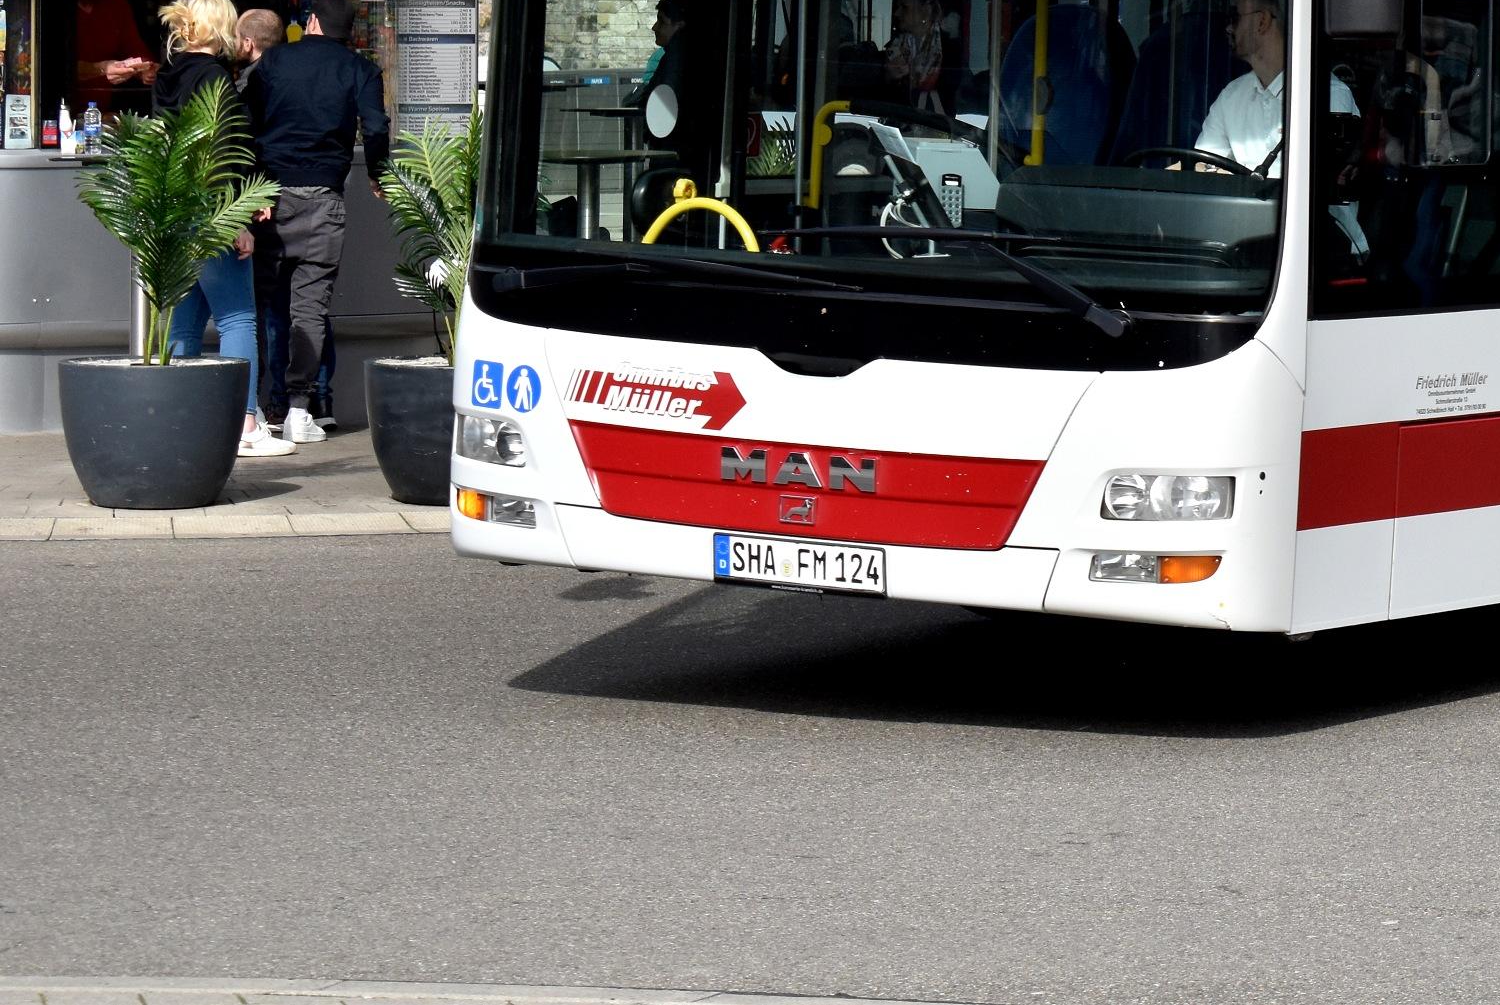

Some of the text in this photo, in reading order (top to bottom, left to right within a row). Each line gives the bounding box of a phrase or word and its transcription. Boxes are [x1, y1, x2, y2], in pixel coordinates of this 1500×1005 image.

[612, 361, 713, 391] Omnibus
[1416, 371, 1488, 389] Friedrich Müller
[603, 384, 703, 420] Müller
[720, 445, 878, 493] MAN
[732, 541, 776, 576] SHA
[797, 548, 827, 581] FM
[835, 552, 880, 585] 124
